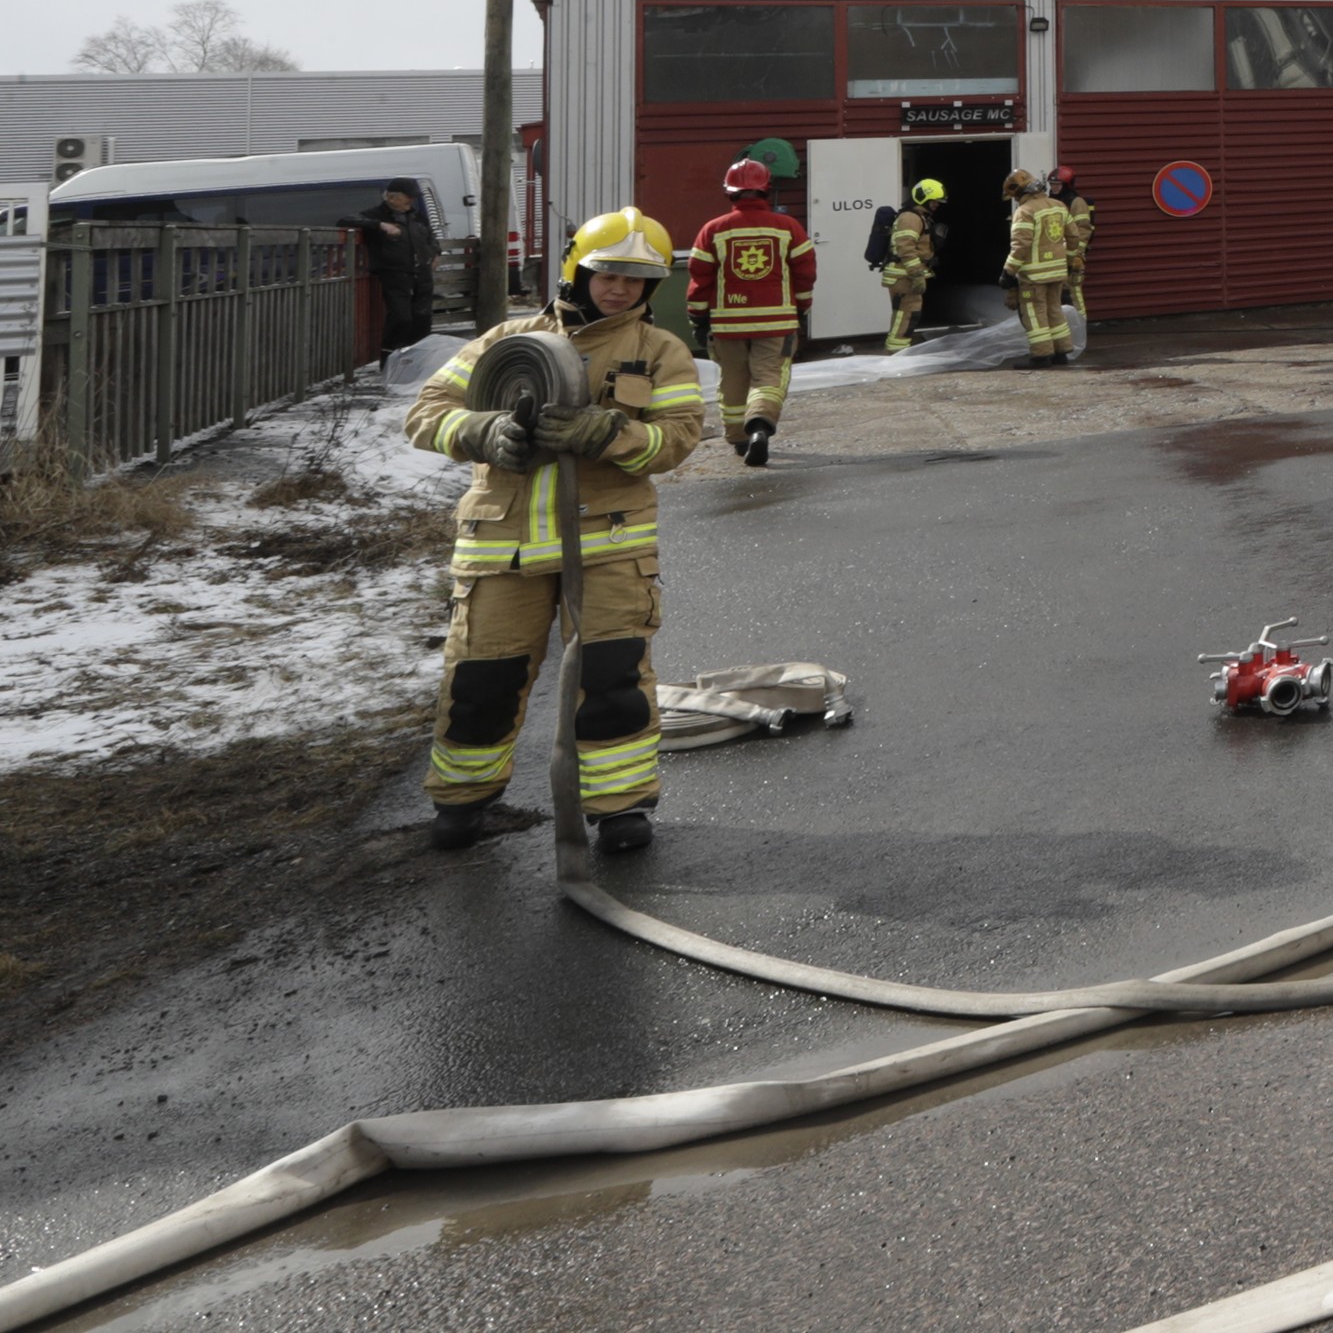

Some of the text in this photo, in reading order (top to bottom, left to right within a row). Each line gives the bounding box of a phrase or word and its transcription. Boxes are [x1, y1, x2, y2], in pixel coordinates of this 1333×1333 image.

[906, 108, 1011, 122] SAUSAGE MC
[832, 198, 874, 212] ULOS
[727, 293, 749, 304] VNe
